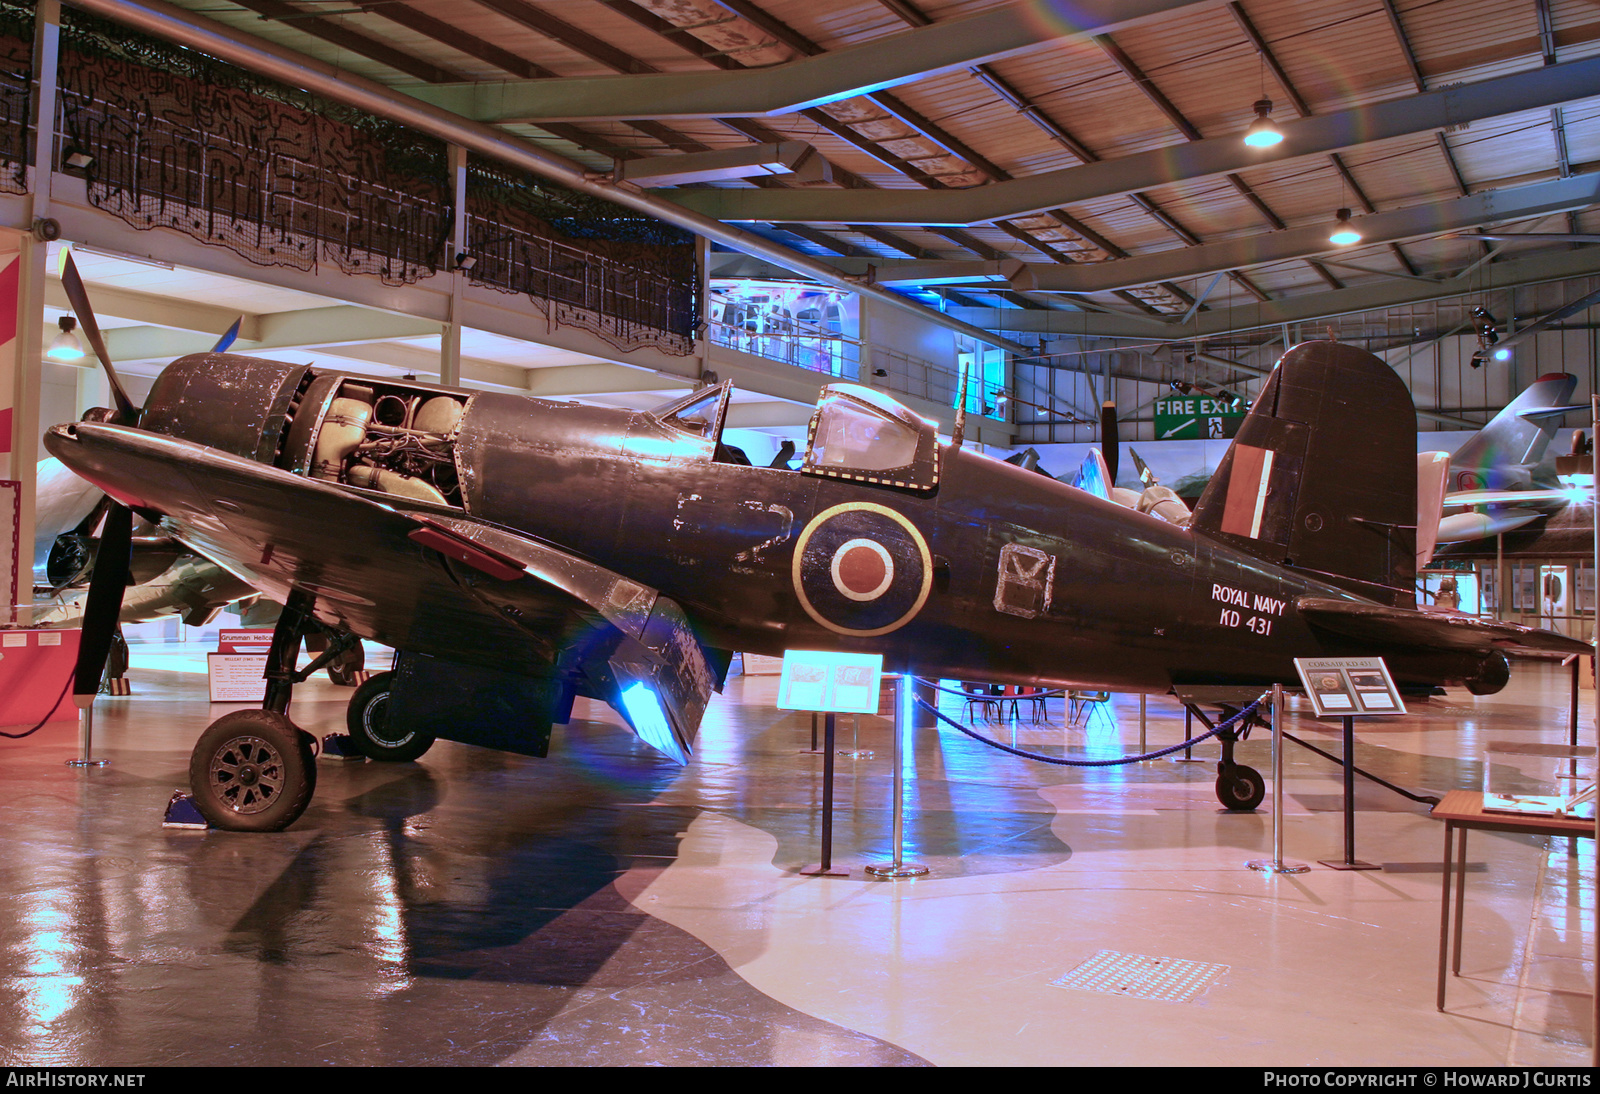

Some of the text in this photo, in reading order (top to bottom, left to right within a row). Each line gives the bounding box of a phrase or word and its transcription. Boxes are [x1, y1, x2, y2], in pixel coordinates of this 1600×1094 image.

[1156, 400, 1195, 415] FIRE
[1212, 583, 1286, 616] ROYAL NAVY
[1219, 608, 1272, 636] KD 431
